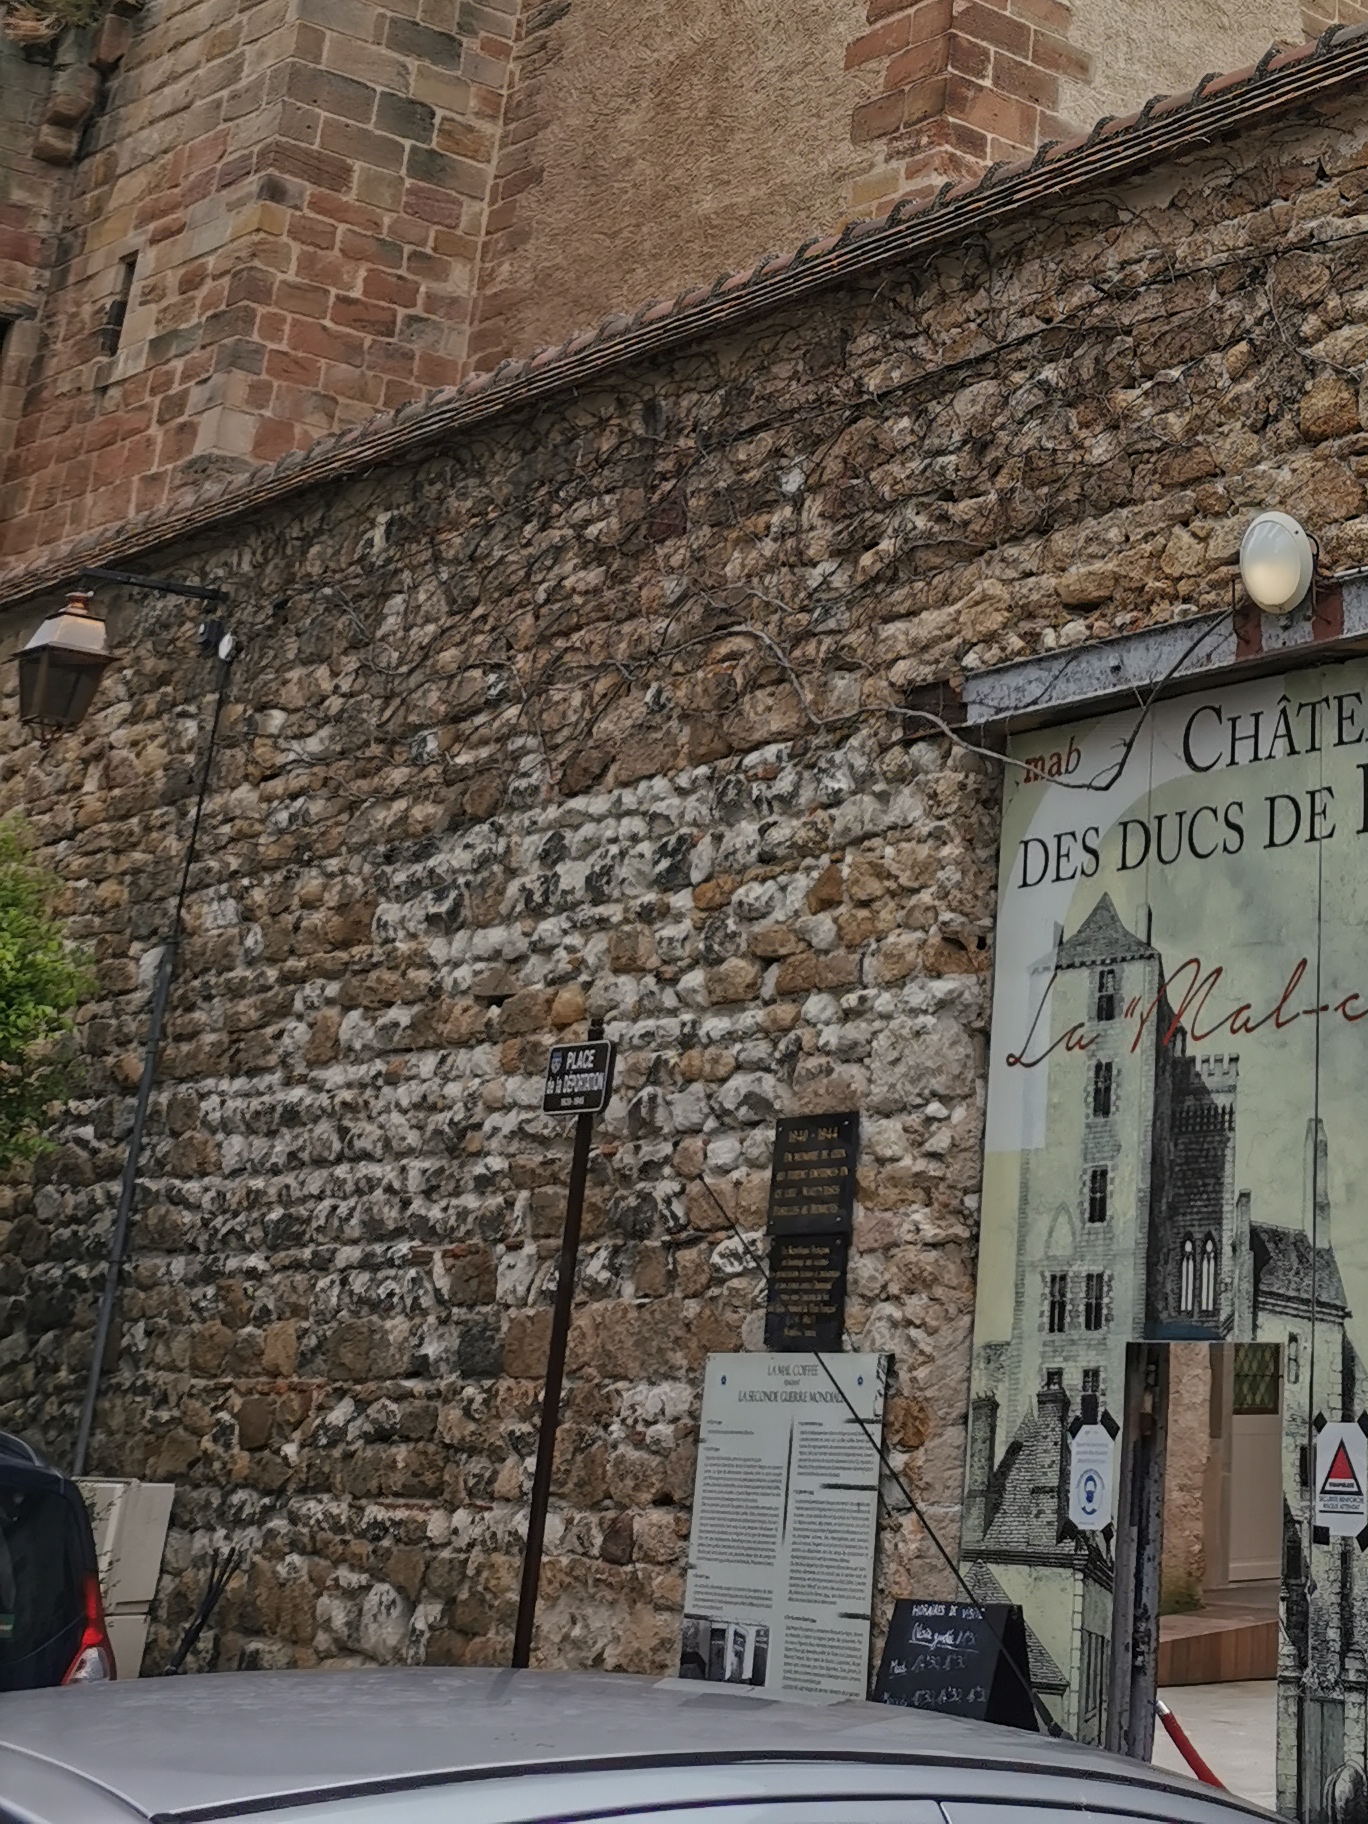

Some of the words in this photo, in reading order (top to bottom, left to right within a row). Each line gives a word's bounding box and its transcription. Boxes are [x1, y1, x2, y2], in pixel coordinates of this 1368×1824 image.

[1023, 735, 1082, 785] mab
[1017, 826, 1101, 890] DES
[1116, 800, 1245, 873] DUCS
[1263, 785, 1337, 850] DE
[565, 1049, 596, 1070] PLACE
